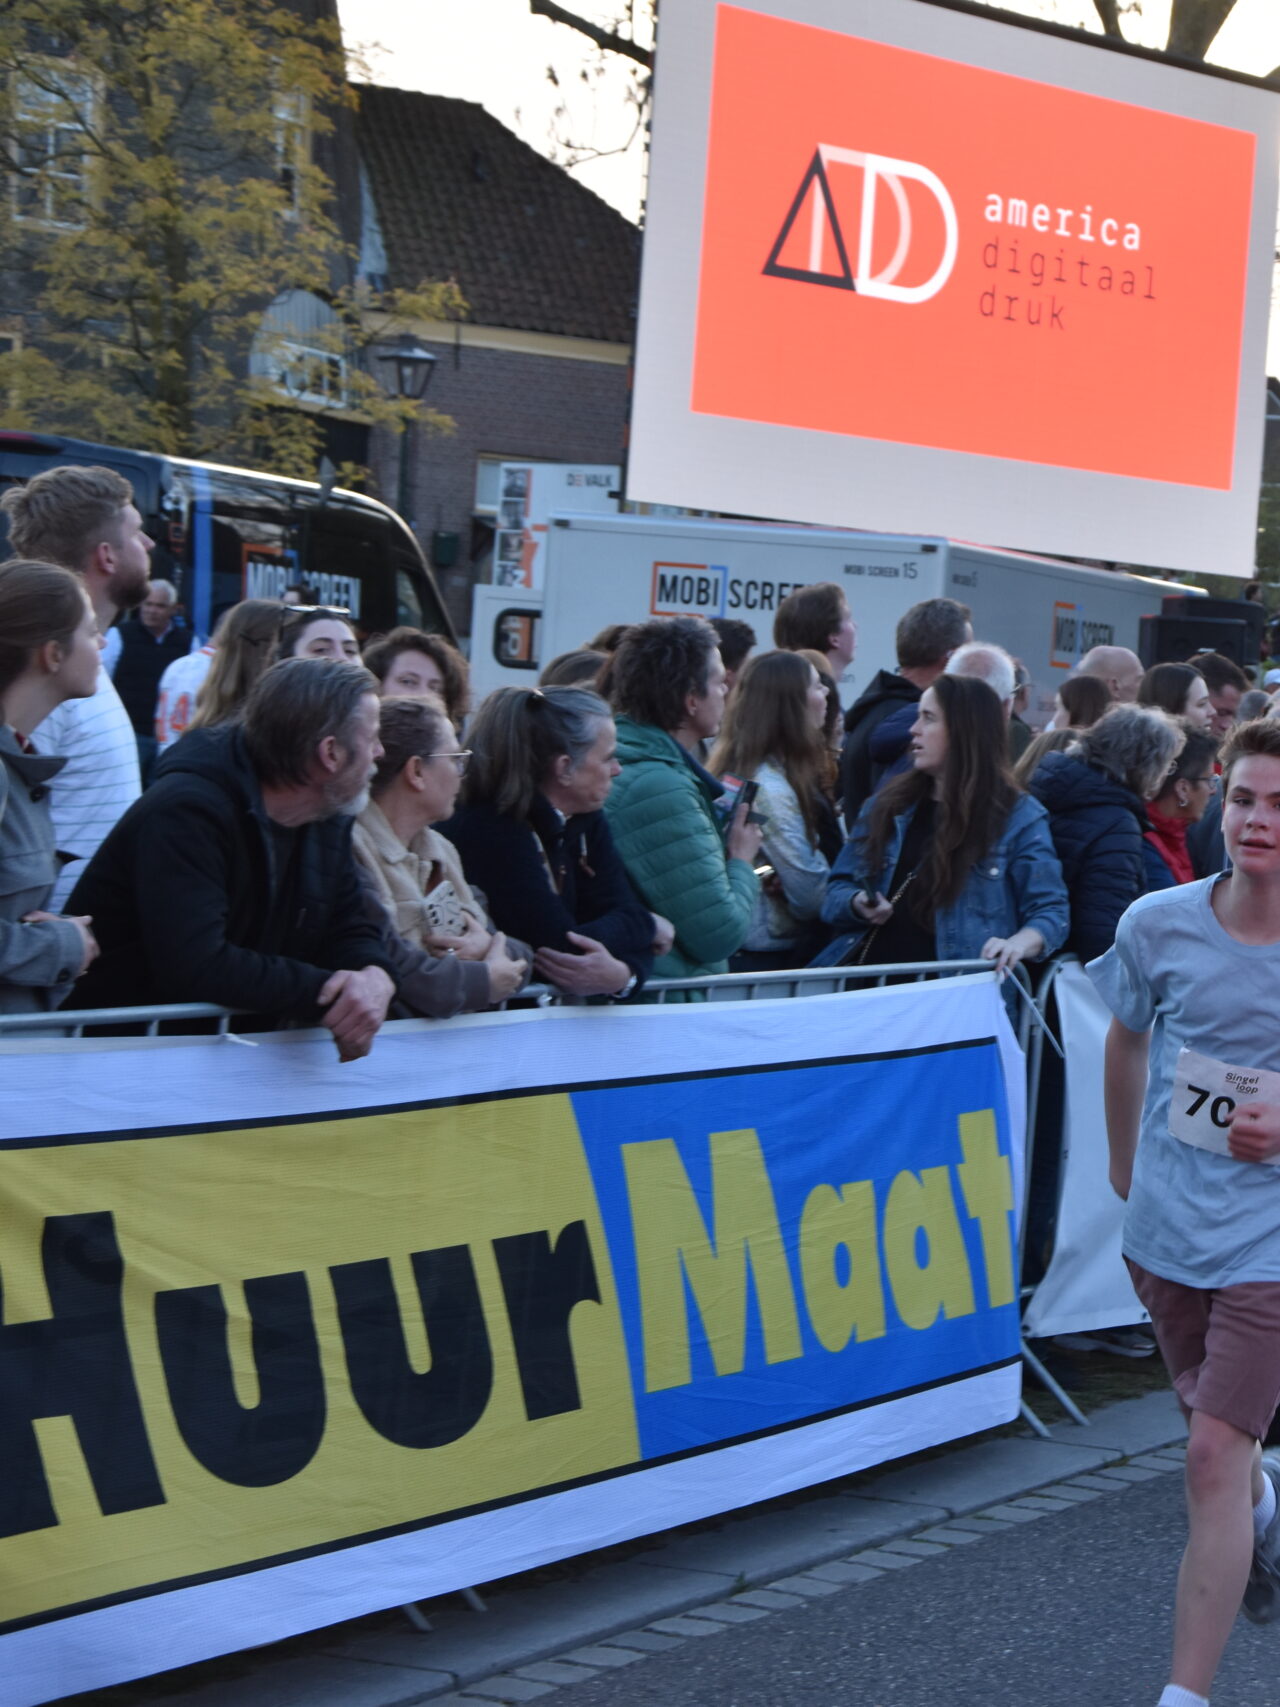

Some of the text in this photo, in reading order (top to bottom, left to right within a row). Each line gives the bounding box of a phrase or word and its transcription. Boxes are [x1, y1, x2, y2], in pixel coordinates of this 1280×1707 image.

[983, 193, 1142, 251] america
[982, 236, 1157, 301] digitaal
[978, 284, 1066, 331] druk
[903, 562, 918, 579] 15
[657, 574, 806, 611] MOBI SCRE
[1226, 1072, 1260, 1085] Singel
[1236, 1082, 1259, 1095] loop
